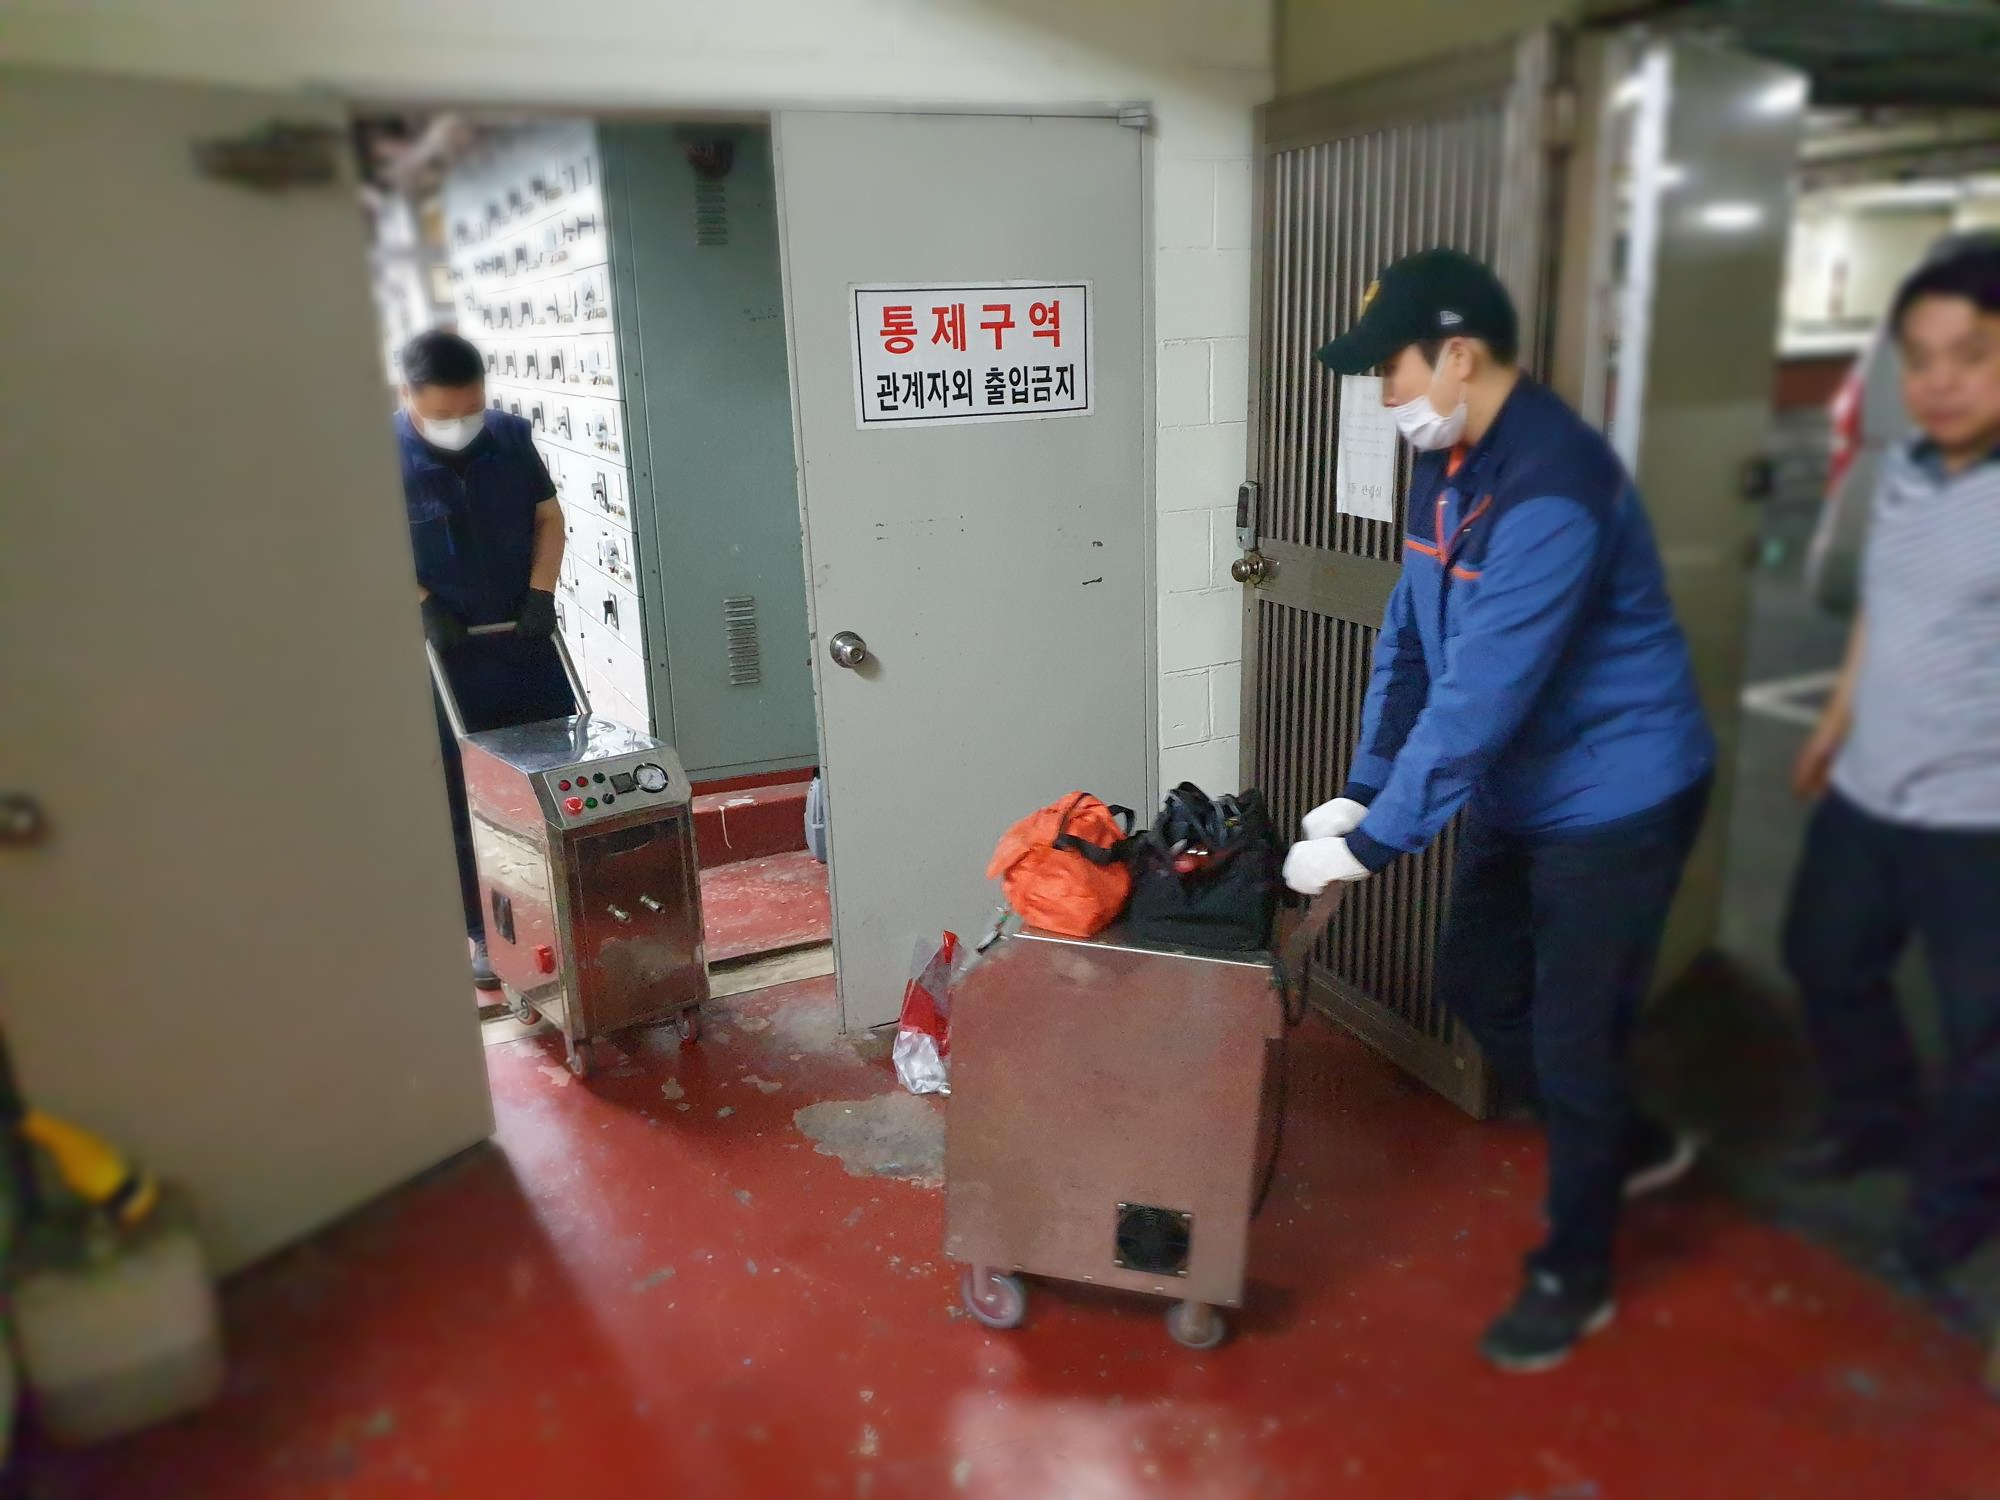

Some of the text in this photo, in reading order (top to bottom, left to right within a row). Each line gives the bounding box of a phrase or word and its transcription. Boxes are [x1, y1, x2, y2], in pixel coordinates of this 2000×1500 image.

[879, 300, 1061, 355] 통제구역
[876, 363, 1075, 412] 관계자외 출입금지
